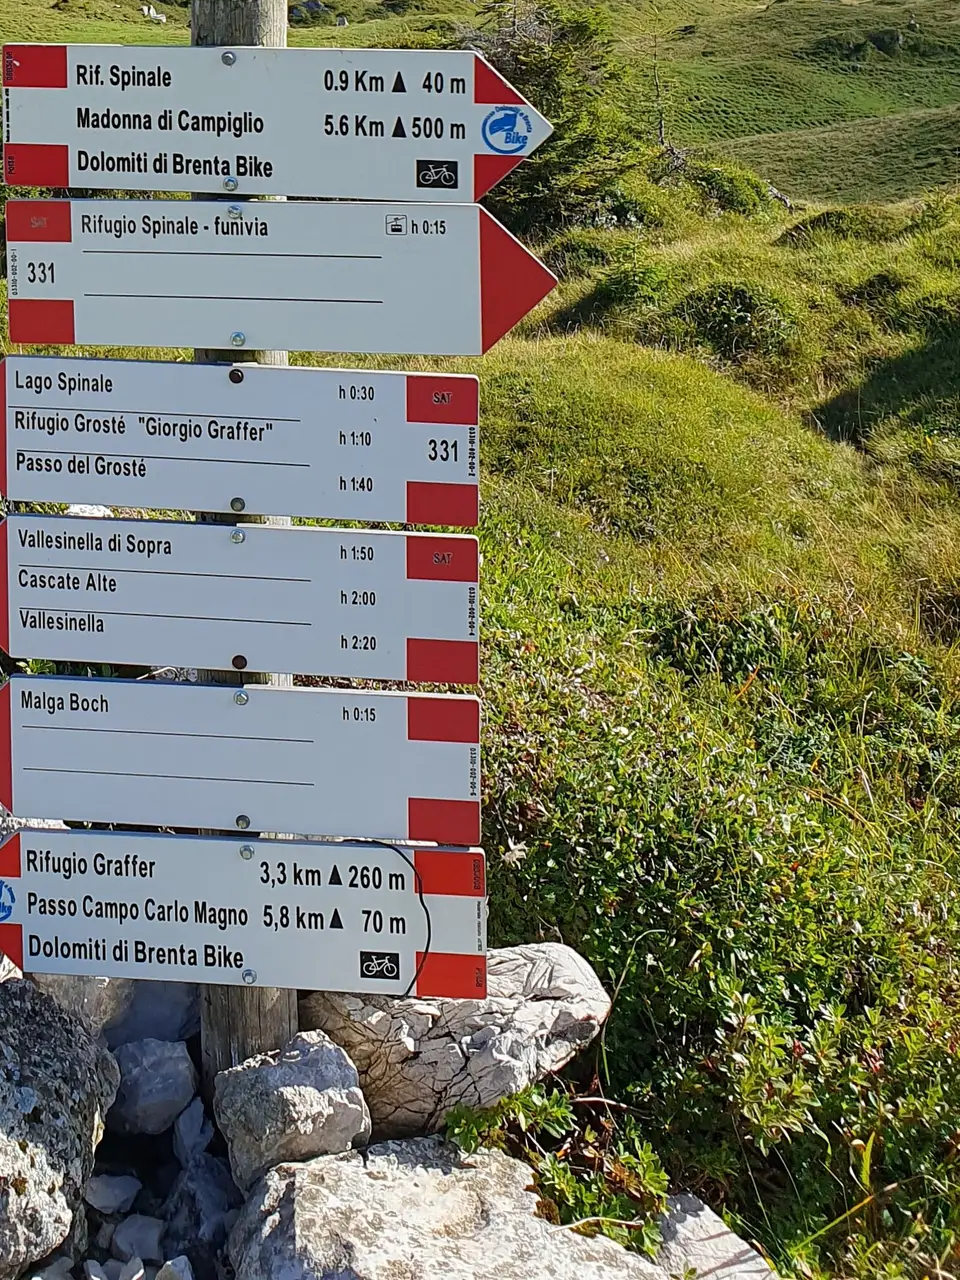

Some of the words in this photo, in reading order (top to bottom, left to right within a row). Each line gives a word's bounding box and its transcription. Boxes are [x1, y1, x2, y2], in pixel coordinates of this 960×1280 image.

[76, 64, 104, 86] Rif.
[109, 64, 172, 92] Spinale
[324, 69, 349, 92] 0.9
[354, 70, 385, 93] Km
[422, 71, 444, 94] 40
[450, 77, 466, 95] m
[76, 107, 152, 130] Madonna
[157, 109, 173, 131] di
[177, 109, 264, 138] Campiglio
[324, 114, 349, 136] 5.6
[354, 114, 385, 137] Km
[411, 116, 444, 139] 500
[450, 123, 466, 140] m
[504, 132, 528, 144] Bike
[77, 150, 148, 174] Dolomiti
[152, 152, 168, 174] di
[172, 152, 231, 176] Brenta
[235, 155, 273, 178] Bike
[81, 214, 137, 239] Rifugio
[141, 215, 199, 239] Spinale
[214, 216, 269, 237] funivia
[411, 219, 419, 234] h
[422, 220, 446, 235] 0:15
[27, 262, 55, 284] 331
[15, 370, 53, 395] Lago
[57, 373, 113, 396] Spinale
[339, 384, 346, 400] h
[349, 385, 375, 401] 0:30
[433, 392, 452, 404] SAT
[14, 410, 69, 436] Rifugio
[74, 413, 126, 435] Grosté
[138, 416, 202, 442] "Giorgio
[208, 419, 273, 442] Graffer"
[339, 430, 347, 445] h
[350, 431, 372, 447] 1:10
[428, 438, 458, 462] 331
[16, 452, 62, 473] Passo
[67, 455, 90, 475] del
[94, 456, 147, 478] Grosté
[339, 476, 347, 491] h
[350, 476, 373, 492] 1:40
[17, 528, 103, 552] Vallesinella
[108, 533, 121, 553] di
[126, 534, 172, 559] Sopra
[340, 544, 347, 560] h
[351, 545, 374, 561] 1:50
[433, 552, 452, 565] SAT
[18, 569, 80, 591] Cascate
[85, 572, 117, 593] Alte
[340, 590, 348, 605] h
[351, 590, 376, 606] 2:00
[19, 610, 105, 633] Vallesinella
[340, 634, 348, 649] h
[351, 635, 377, 651] 2:20
[21, 690, 65, 715] Malga
[69, 692, 109, 713] Boch
[342, 706, 350, 721] h
[353, 707, 376, 722] 0:15
[26, 849, 88, 879] Rifugio
[93, 852, 156, 878] Graffer
[260, 861, 287, 889] 3,3
[293, 862, 322, 887] km
[348, 865, 382, 890] 260
[388, 872, 405, 891] m
[27, 892, 78, 917] Passo
[82, 895, 139, 925] Campo
[144, 898, 189, 923] Carlo
[194, 901, 248, 931] Magno
[263, 904, 290, 932] 5,8
[296, 905, 324, 930] km
[361, 909, 383, 934] 70
[389, 916, 406, 935] m
[28, 934, 106, 961] Dolomiti
[112, 939, 129, 962] di
[134, 940, 198, 967] Brenta
[203, 944, 244, 969] Bike
